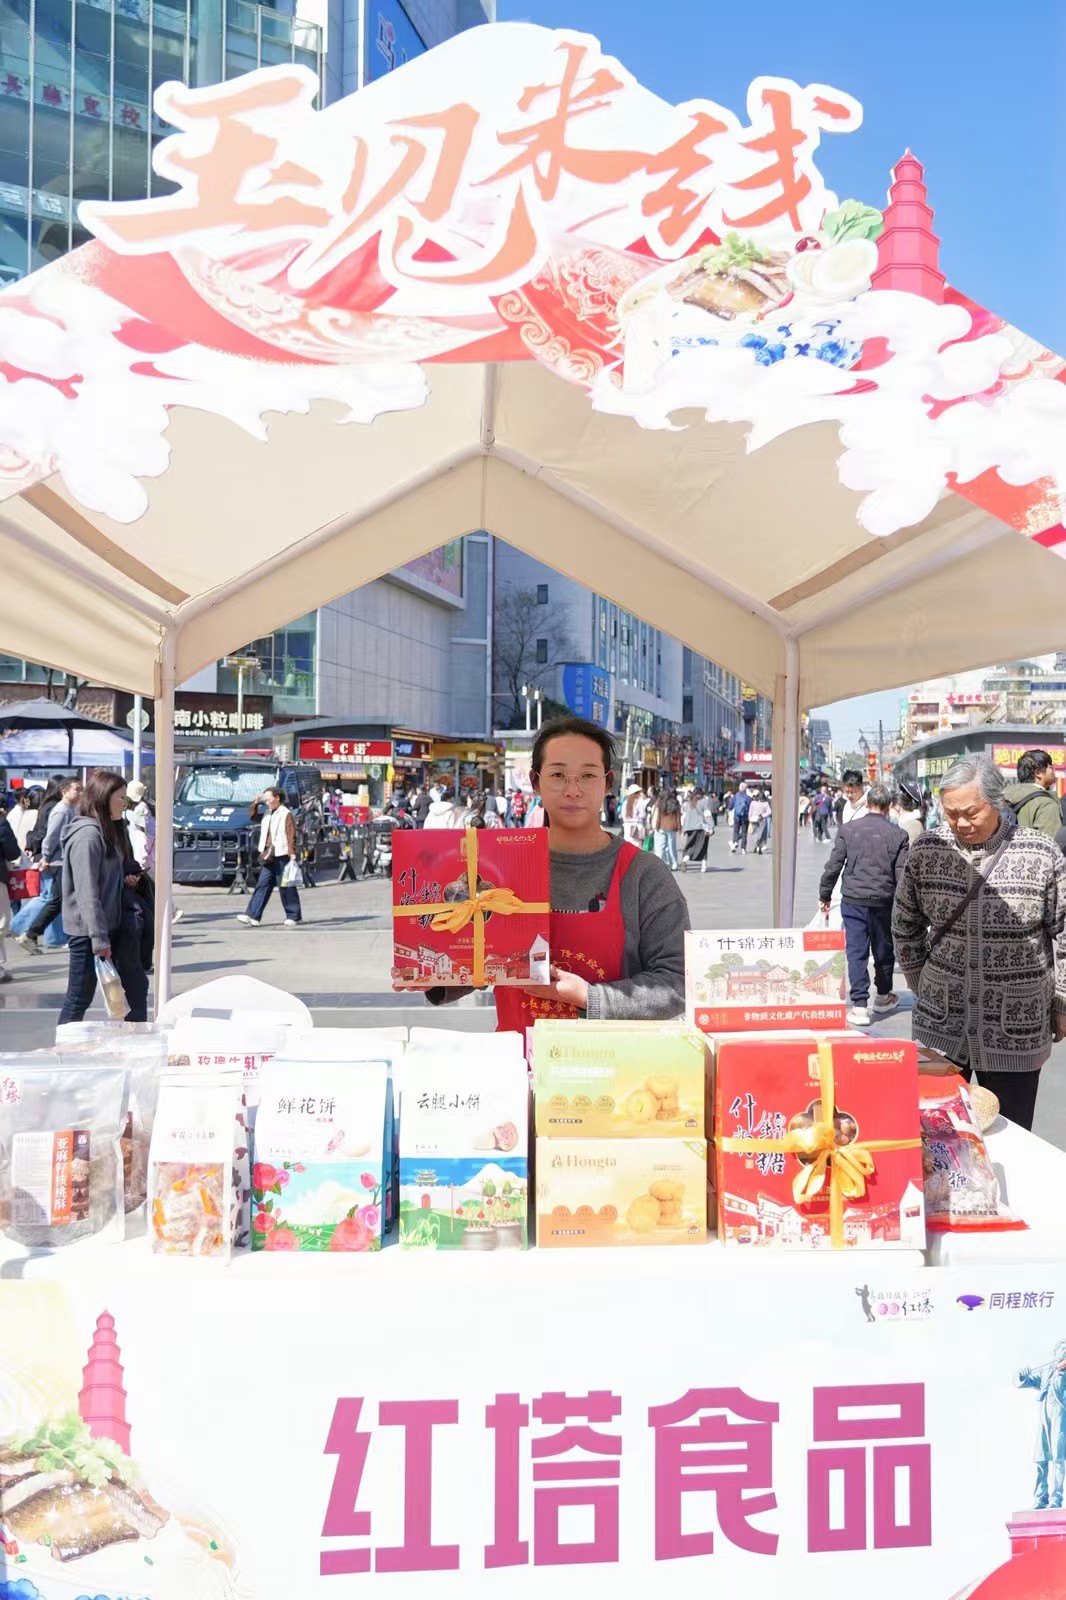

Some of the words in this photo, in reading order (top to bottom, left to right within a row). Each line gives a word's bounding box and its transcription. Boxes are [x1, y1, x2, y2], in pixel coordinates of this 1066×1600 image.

[717, 936, 795, 950] 什锦南糖
[743, 1010, 843, 1022] 非物质文化遗产代表性项目
[277, 1096, 337, 1115] 鲜花饼
[416, 1092, 481, 1111] 云腿小饼
[566, 1154, 618, 1169] Hongta
[901, 1297, 934, 1317] 红塔
[989, 1291, 1055, 1310] 同程旅行
[320, 1382, 932, 1576] 红塔食品
